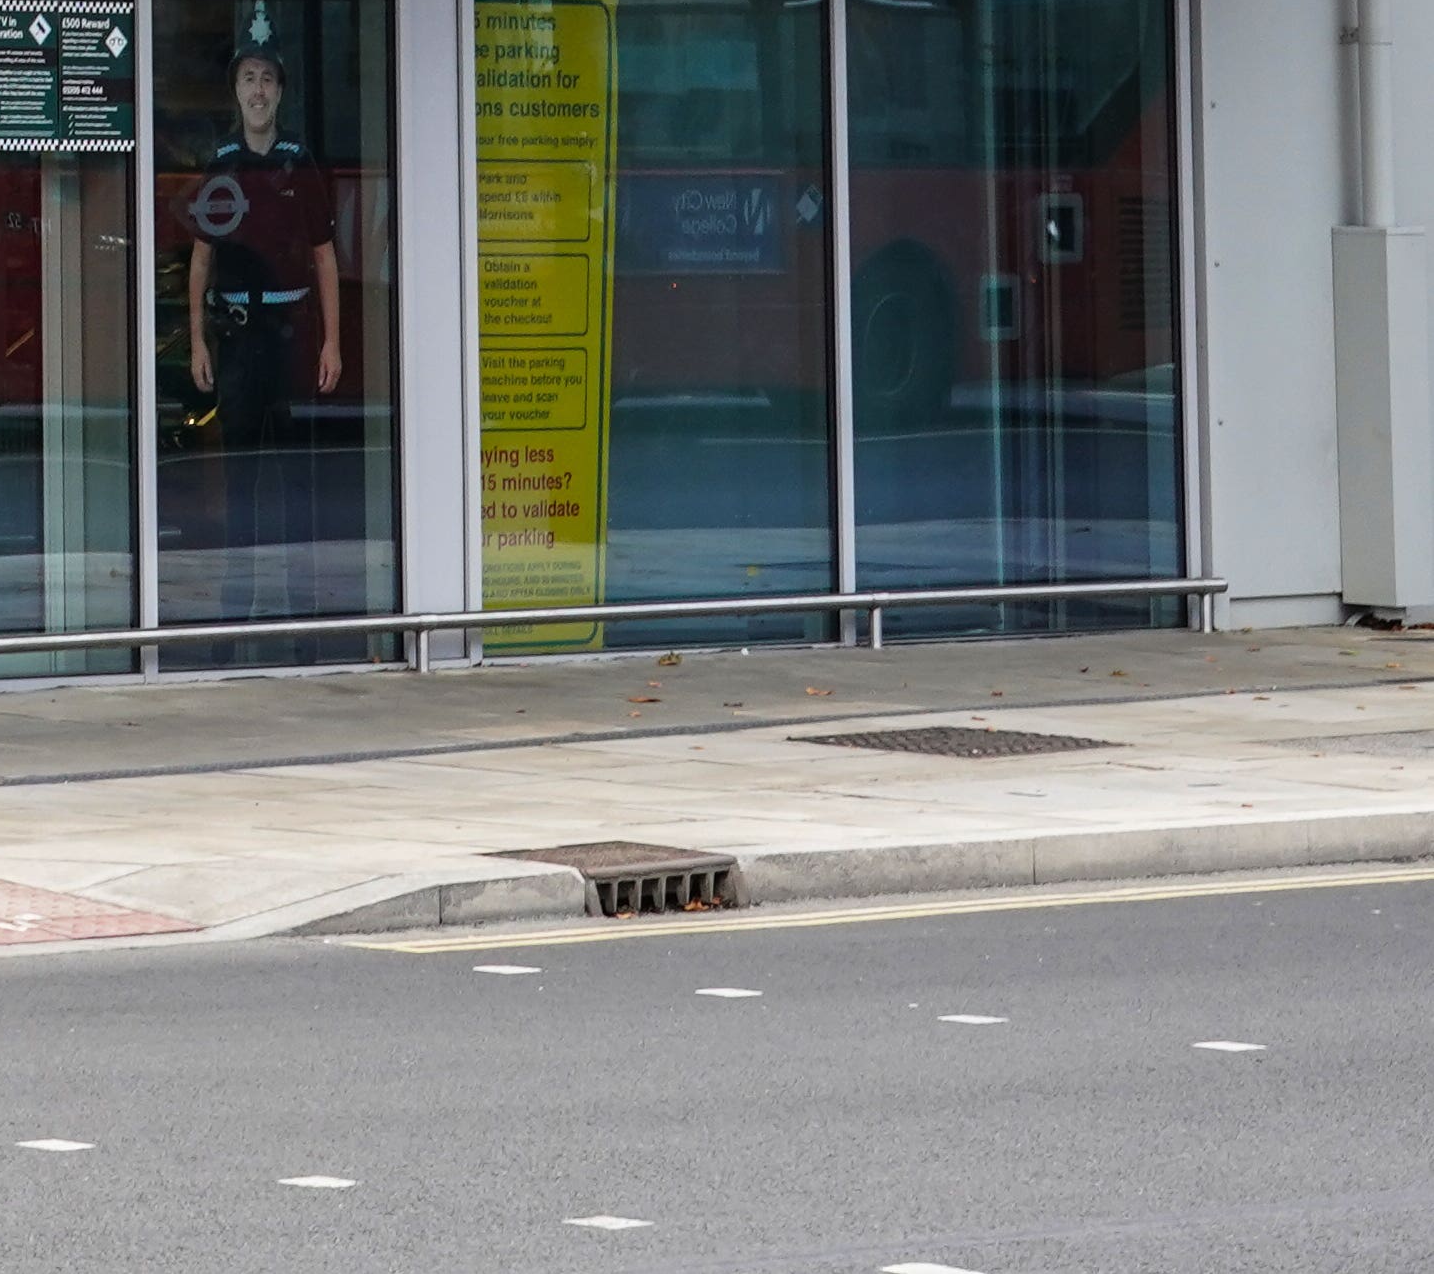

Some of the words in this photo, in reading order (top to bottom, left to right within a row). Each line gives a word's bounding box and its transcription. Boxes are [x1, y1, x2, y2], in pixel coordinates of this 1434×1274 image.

[8, 15, 17, 27] in
[61, 17, 80, 30] £500
[81, 17, 111, 30] Reward
[486, 12, 556, 31] minutes
[495, 42, 560, 64] parking
[476, 69, 550, 88] alidation
[556, 69, 580, 88] for
[509, 100, 600, 118] customers
[498, 134, 518, 146] free
[521, 134, 559, 147] parking
[478, 209, 534, 220] Morrisons
[483, 260, 521, 273] Obtain
[523, 262, 530, 273] a
[483, 278, 538, 290] validation
[483, 296, 528, 308] voucher
[483, 313, 501, 324] the
[503, 313, 552, 324] checkout
[481, 357, 505, 369] Visit
[508, 356, 526, 368] the
[528, 356, 565, 371] parking
[481, 374, 528, 386] machine
[530, 374, 562, 385] before
[563, 375, 583, 387] you
[481, 392, 509, 403] leave
[513, 392, 533, 402] and
[536, 392, 558, 402] scan
[481, 410, 506, 423] your
[509, 409, 550, 420] voucher
[525, 445, 555, 463] less
[501, 471, 573, 492] minutes?
[501, 503, 518, 518] to
[522, 500, 580, 518] validate
[498, 527, 555, 551] parking
